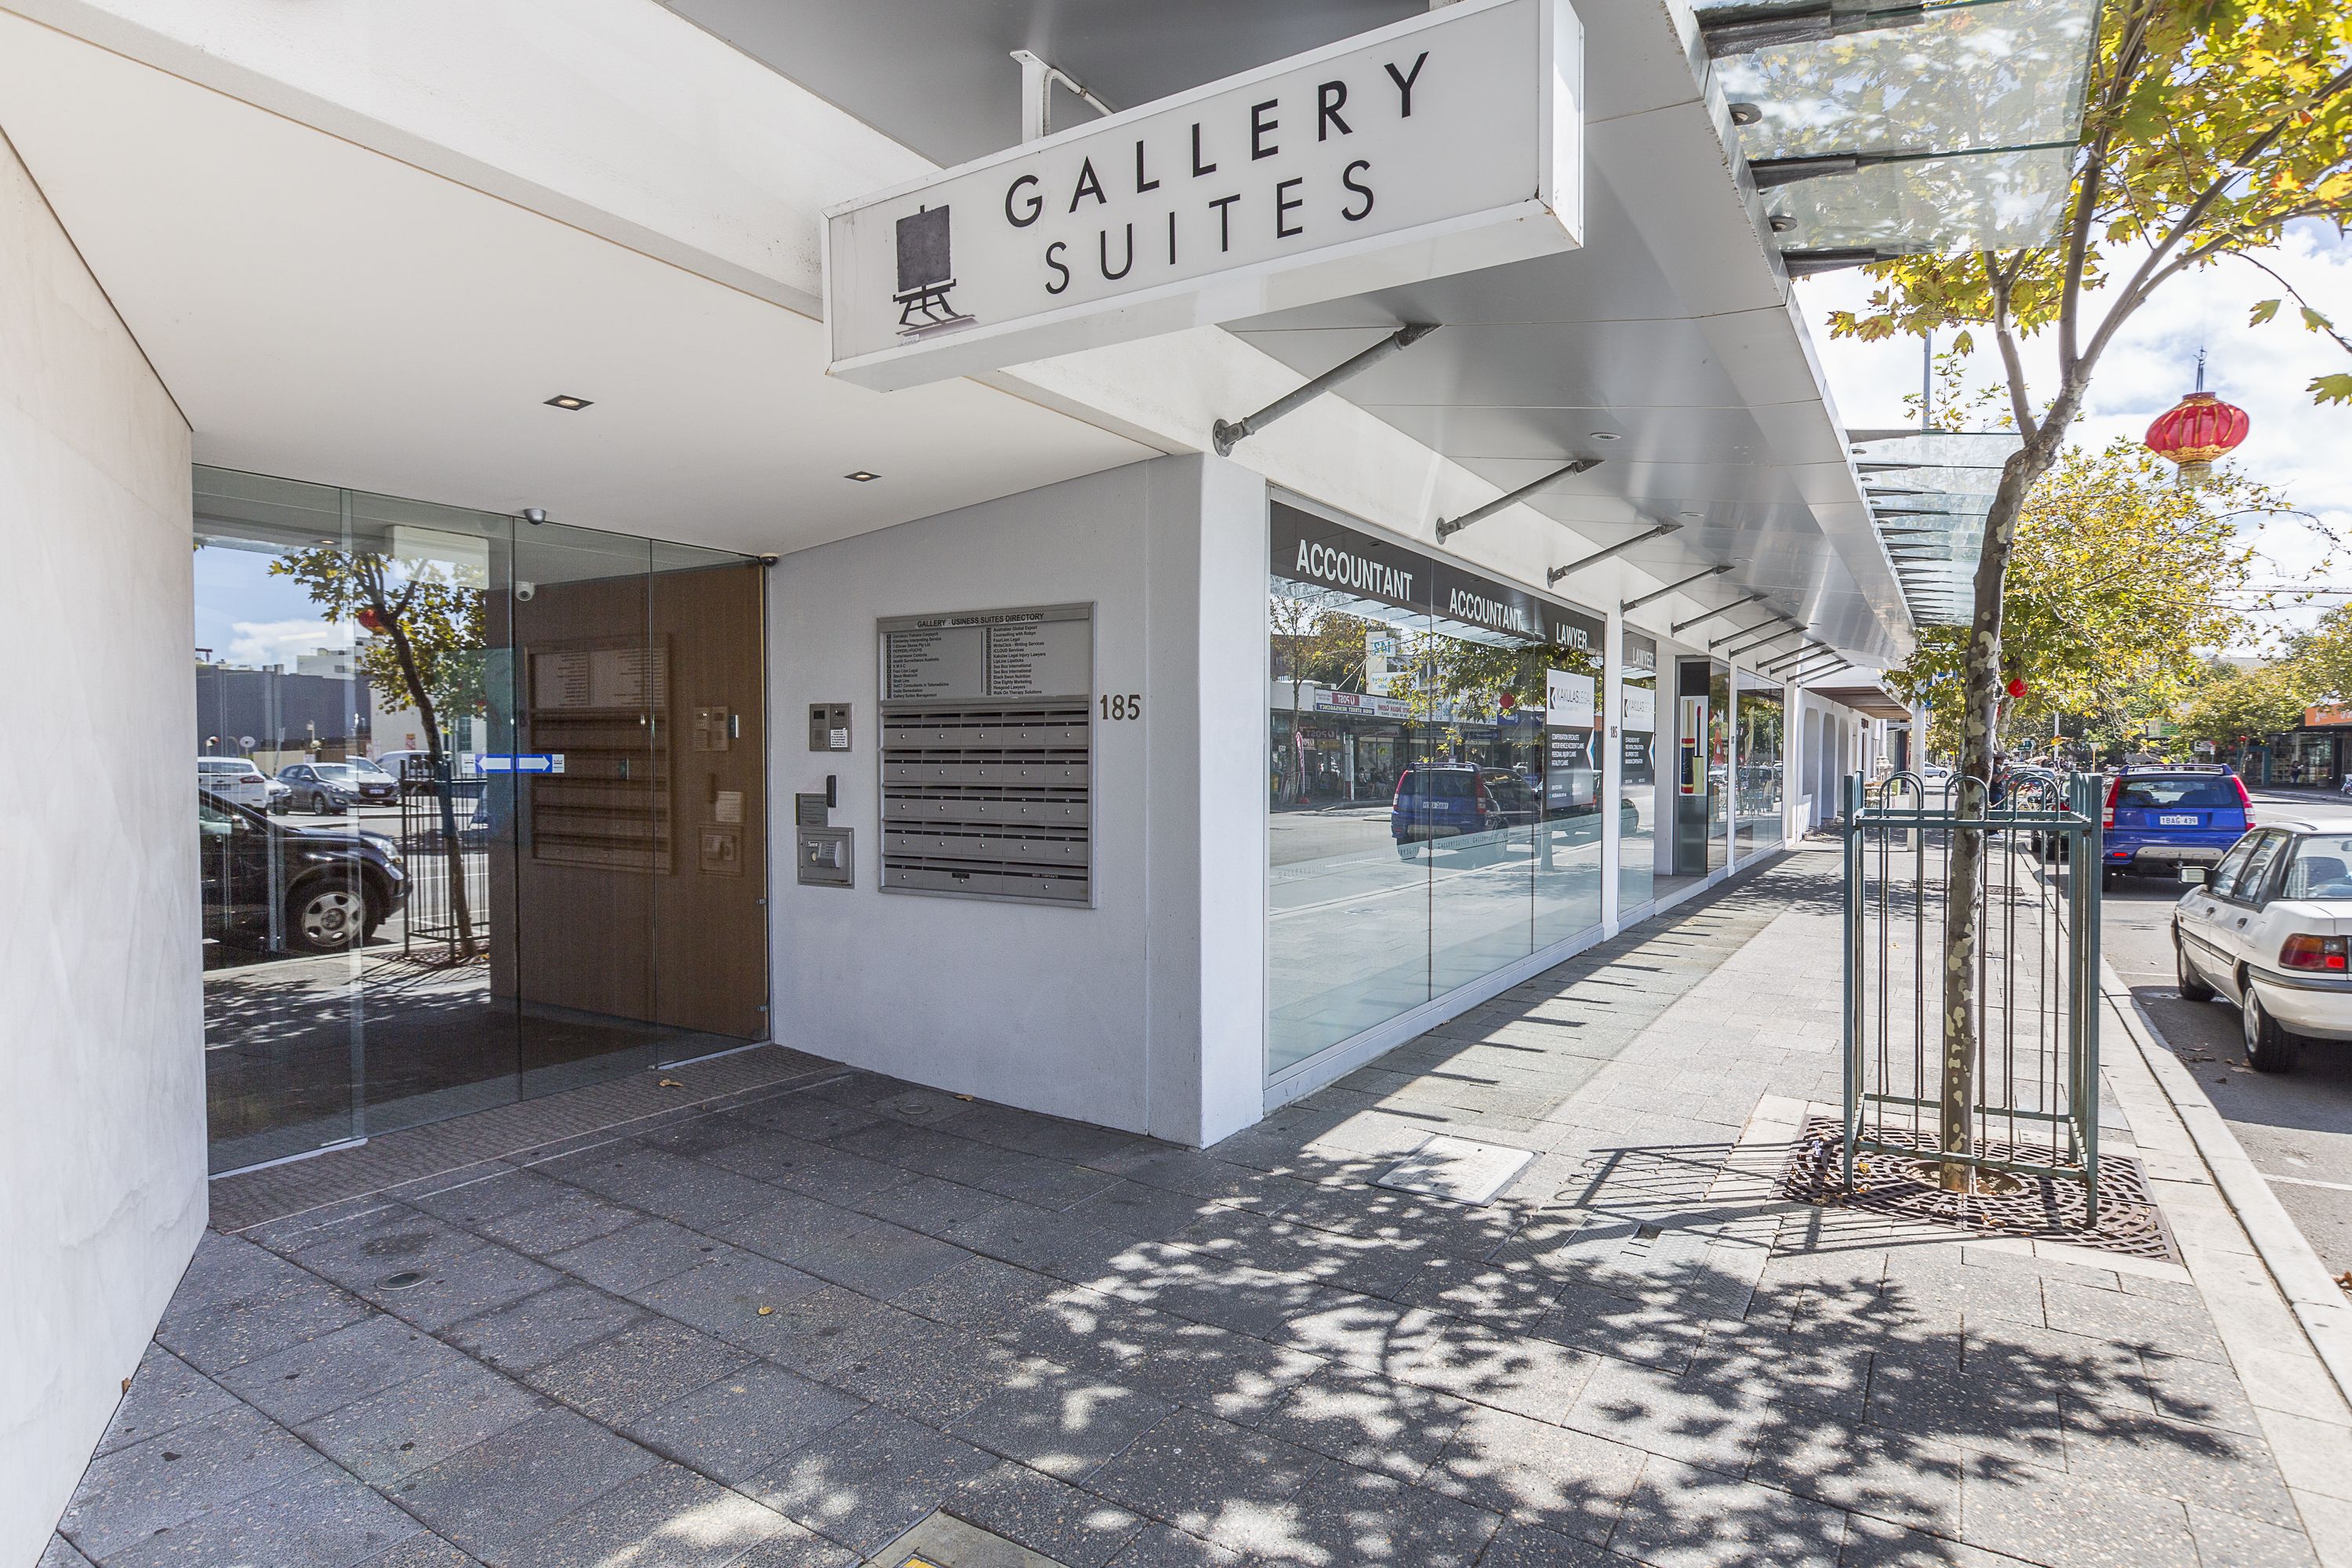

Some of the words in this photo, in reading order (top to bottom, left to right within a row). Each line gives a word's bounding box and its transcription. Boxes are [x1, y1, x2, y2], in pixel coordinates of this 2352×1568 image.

[1004, 50, 1429, 229] GALLERY
[1044, 159, 1374, 296] SUITES
[1296, 539, 1413, 601] ACCOUNTANT
[917, 619, 946, 628] GALLERY
[948, 616, 979, 626] USINESS
[1005, 612, 1044, 622] DIRECTORY
[1449, 587, 1523, 632] ACCOUNTANT
[1555, 622, 1588, 651] LAWYER
[1633, 647, 1653, 669] LAWYER
[1101, 694, 1141, 720] 185
